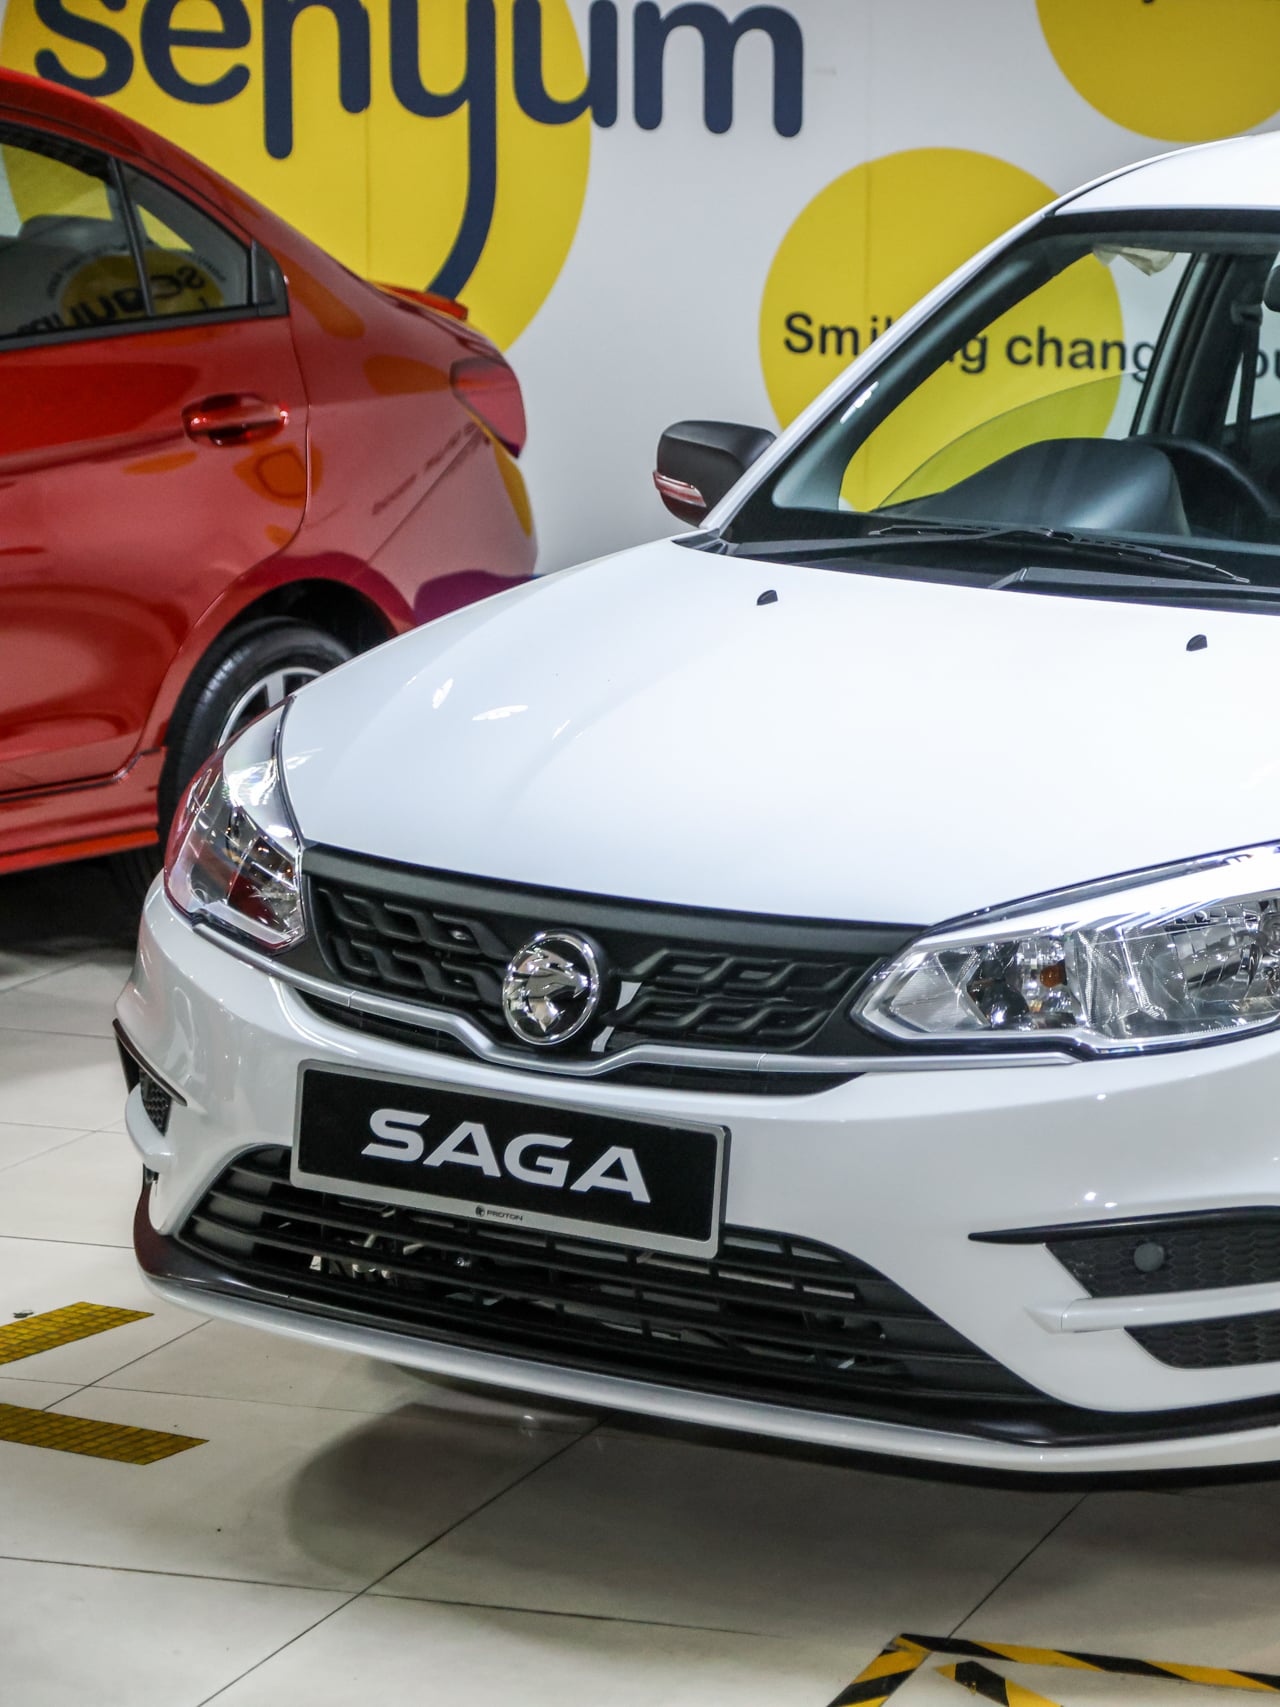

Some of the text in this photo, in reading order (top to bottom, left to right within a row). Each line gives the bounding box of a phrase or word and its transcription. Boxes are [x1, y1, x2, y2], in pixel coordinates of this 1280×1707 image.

[33, 0, 804, 300] senyum
[784, 312, 988, 375] Smig
[1005, 325, 1158, 384] chang
[361, 1108, 651, 1203] SAGA
[486, 1209, 524, 1221] PROTON
